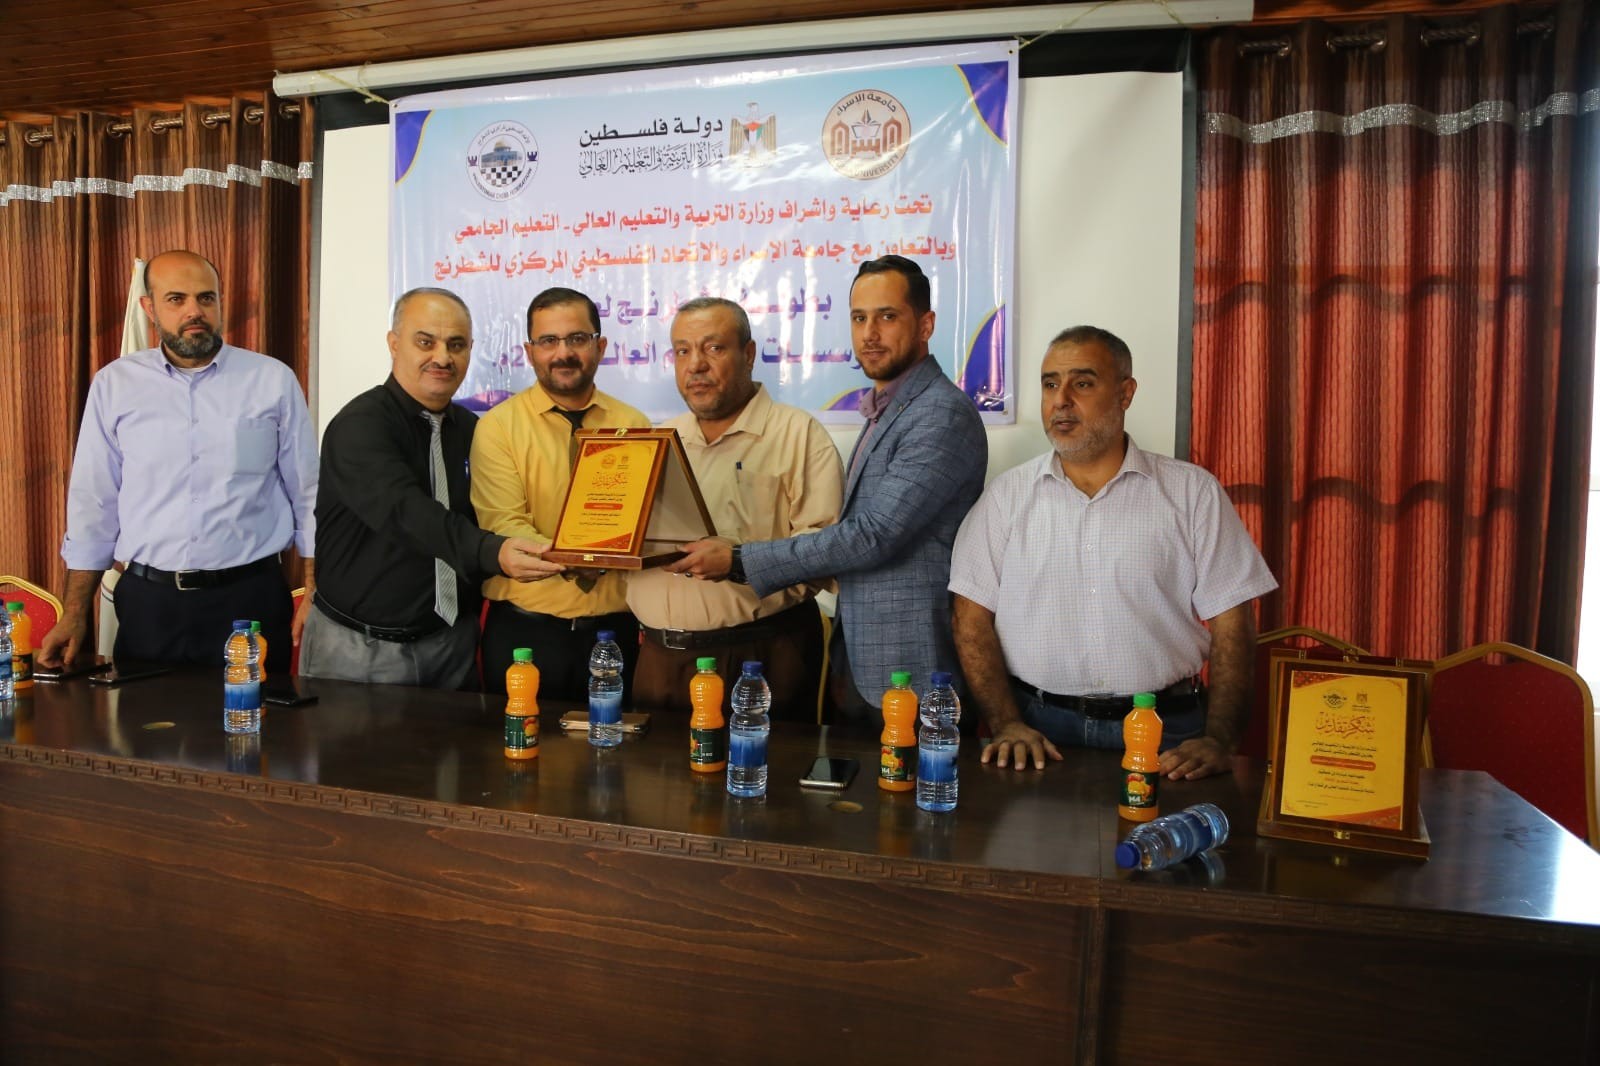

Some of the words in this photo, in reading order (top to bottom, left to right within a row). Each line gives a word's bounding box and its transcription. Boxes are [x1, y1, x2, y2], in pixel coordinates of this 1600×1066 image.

[866, 92, 897, 112] جامعة
[579, 118, 668, 148] فلسطين
[673, 115, 723, 138] دولة
[685, 202, 734, 228] التربية
[738, 200, 774, 225] وزارة
[841, 196, 890, 220] رعاية
[895, 194, 932, 215] تحت
[454, 217, 509, 244] الجامعي
[512, 213, 559, 239] التعليم
[572, 210, 616, 237] العالي
[619, 206, 680, 232] والتعليم
[504, 250, 568, 278] المركزي
[571, 243, 656, 278] الفلسطيني
[792, 239, 846, 263] جامعة
[851, 241, 872, 264] مع
[434, 250, 501, 281] للشطرنج
